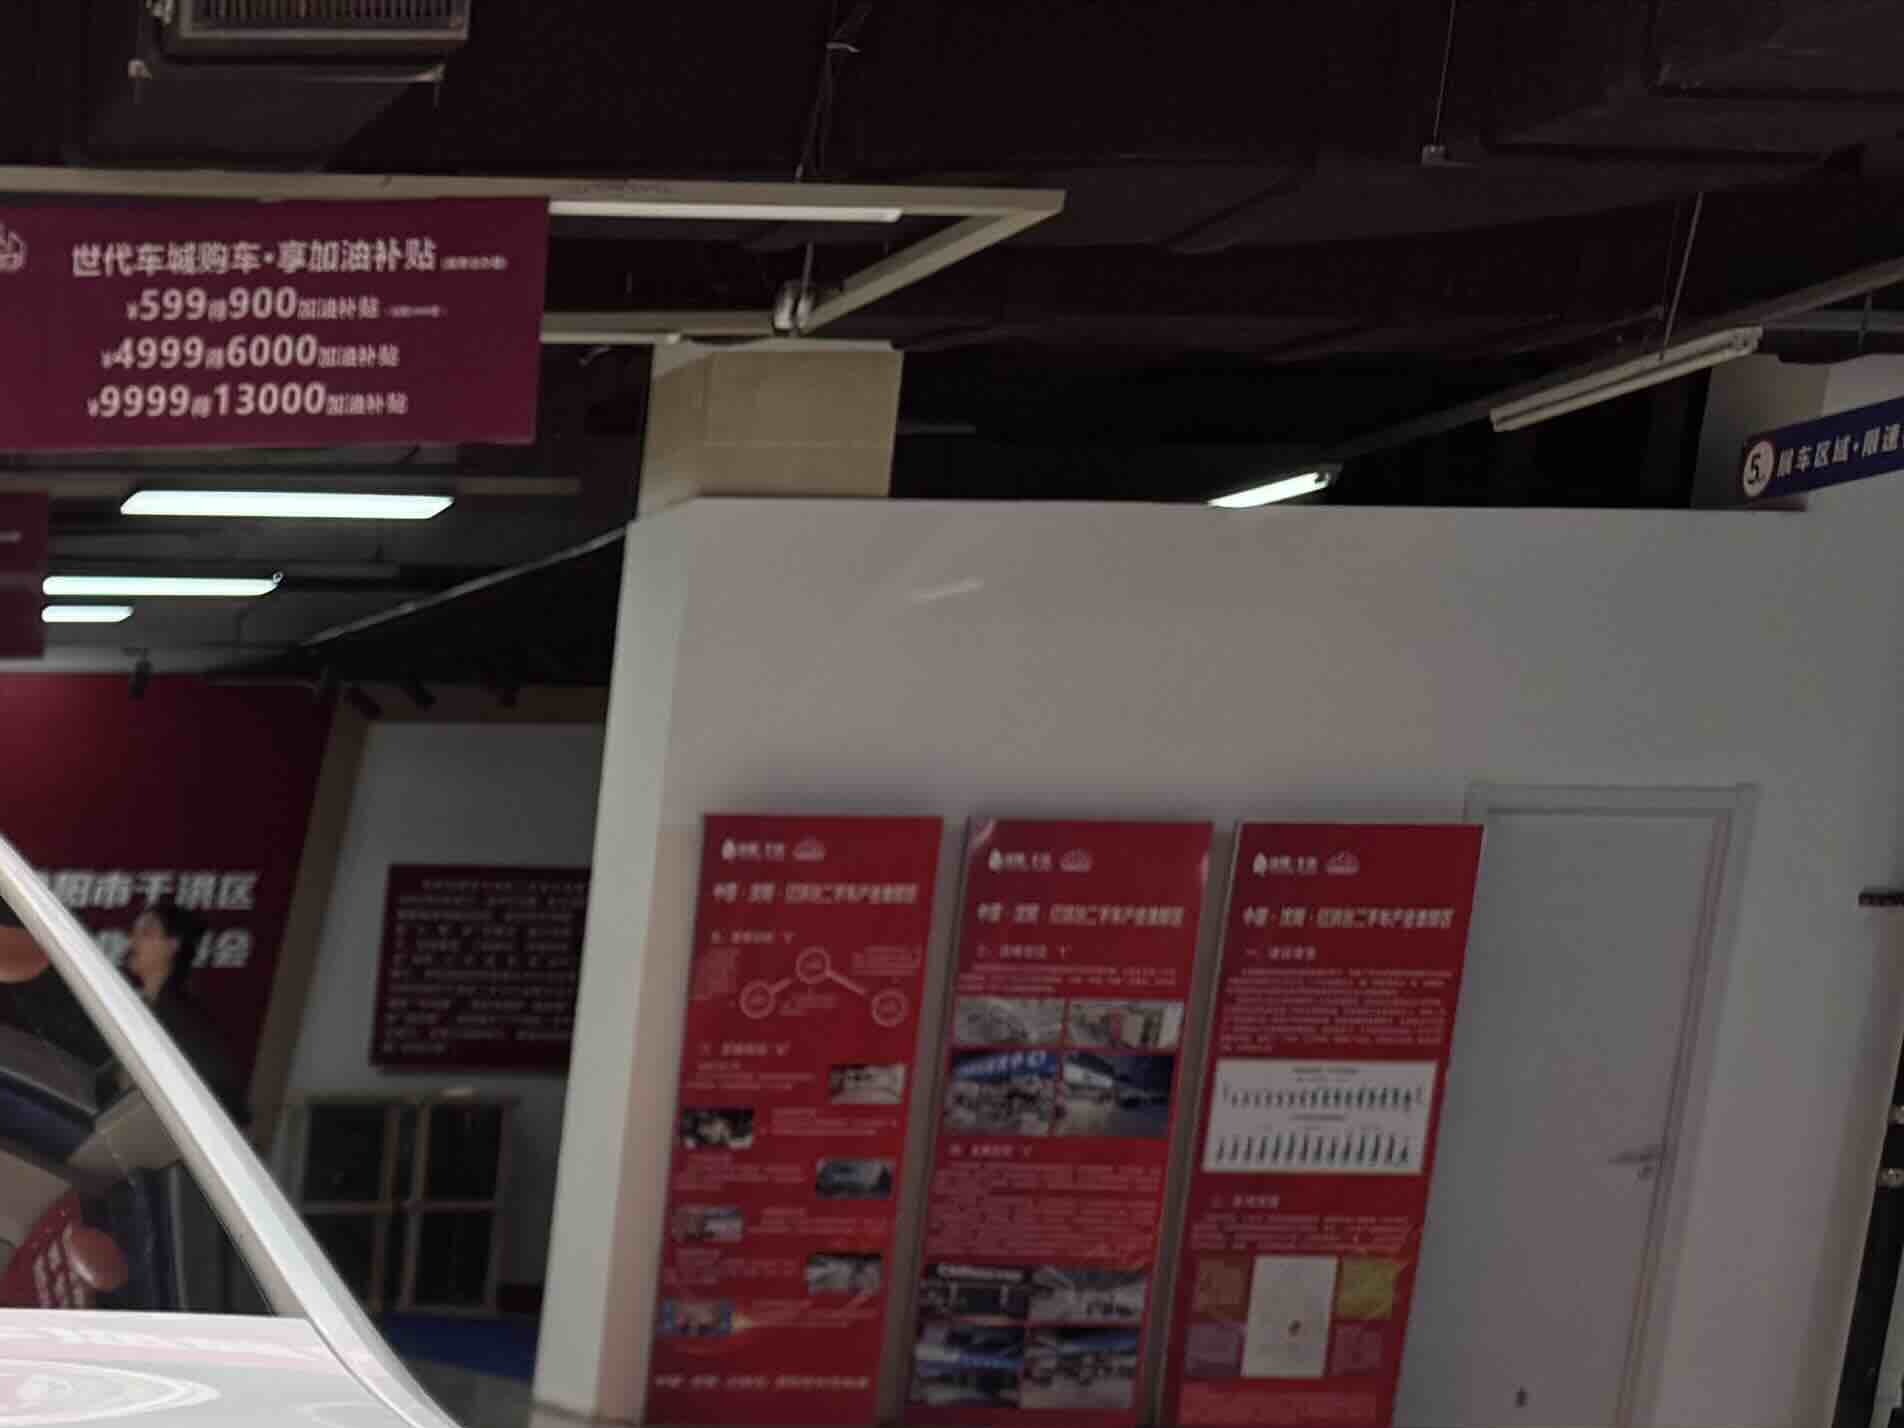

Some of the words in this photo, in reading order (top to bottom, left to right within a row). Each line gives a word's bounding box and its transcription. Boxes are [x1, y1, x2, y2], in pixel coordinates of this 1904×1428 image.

[40, 870, 259, 911] 阳市于洪区
